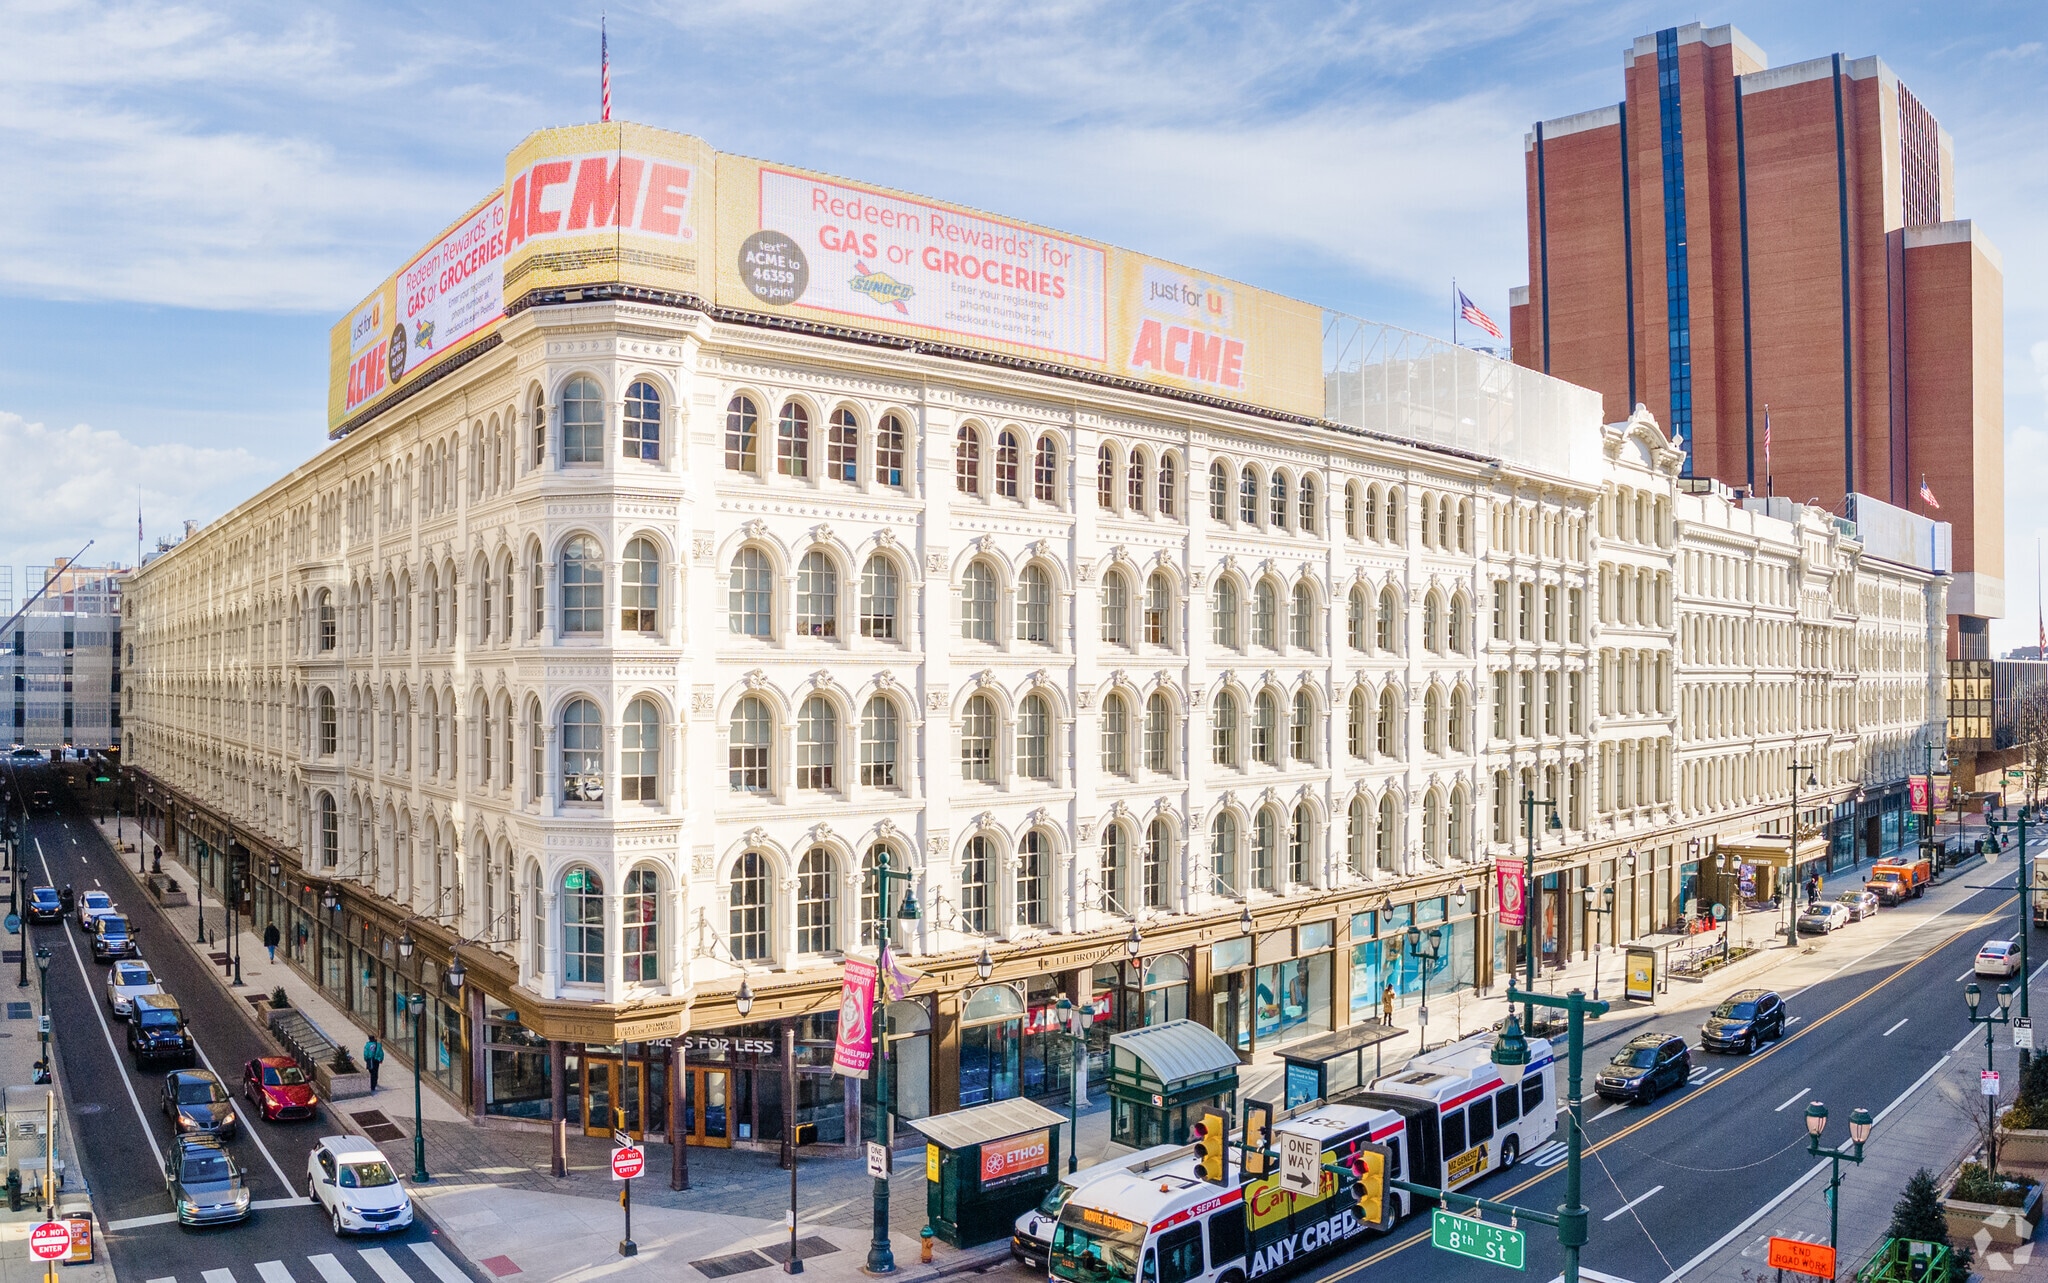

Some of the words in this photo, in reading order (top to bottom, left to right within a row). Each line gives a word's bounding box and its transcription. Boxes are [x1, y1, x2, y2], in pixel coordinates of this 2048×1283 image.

[812, 188, 920, 233] Redeem
[1042, 243, 1072, 268] for
[406, 255, 440, 293] Redeem
[492, 205, 504, 228] fo
[746, 251, 786, 268] ACME
[788, 258, 800, 271] to
[819, 225, 878, 258] GAS
[887, 245, 913, 265] or
[922, 246, 1065, 299] GROCERIES
[407, 288, 425, 318] GAS
[427, 284, 437, 305] or
[439, 229, 504, 295] GROCERIES
[753, 268, 794, 284] 46359
[756, 283, 768, 294] to
[855, 277, 911, 298] SUNOCO
[951, 281, 977, 296] Enter
[979, 288, 1001, 301] your
[1003, 293, 1049, 311] registered
[1150, 281, 1178, 302] just
[1181, 285, 1203, 307] for
[960, 300, 991, 314] phone
[994, 306, 1030, 321] number
[945, 311, 988, 327] checkout
[991, 319, 1000, 329] to
[1002, 323, 1023, 334] earn
[1132, 319, 1244, 387] ACME
[346, 340, 387, 411] ACME
[564, 1024, 594, 1036] LITS
[699, 1037, 729, 1050] FOR
[735, 1039, 773, 1053] LESS
[870, 1145, 883, 1156] ONE
[1006, 1143, 1044, 1164] ETHOS
[1288, 1139, 1313, 1156] ONE
[870, 1155, 883, 1165] WAY
[1288, 1153, 1313, 1170] WAY
[1196, 1198, 1221, 1214] SEPTA
[1084, 1209, 1103, 1225] ROUTE
[1103, 1213, 1133, 1233] DETOURED
[39, 1245, 62, 1253] ENTER
[1250, 1234, 1298, 1278] ANY
[1449, 1231, 1474, 1248] 8th
[1485, 1241, 1506, 1261] St
[1792, 1246, 1811, 1257] END
[1775, 1254, 1799, 1265] ROAD
[1802, 1261, 1827, 1271] WORK
